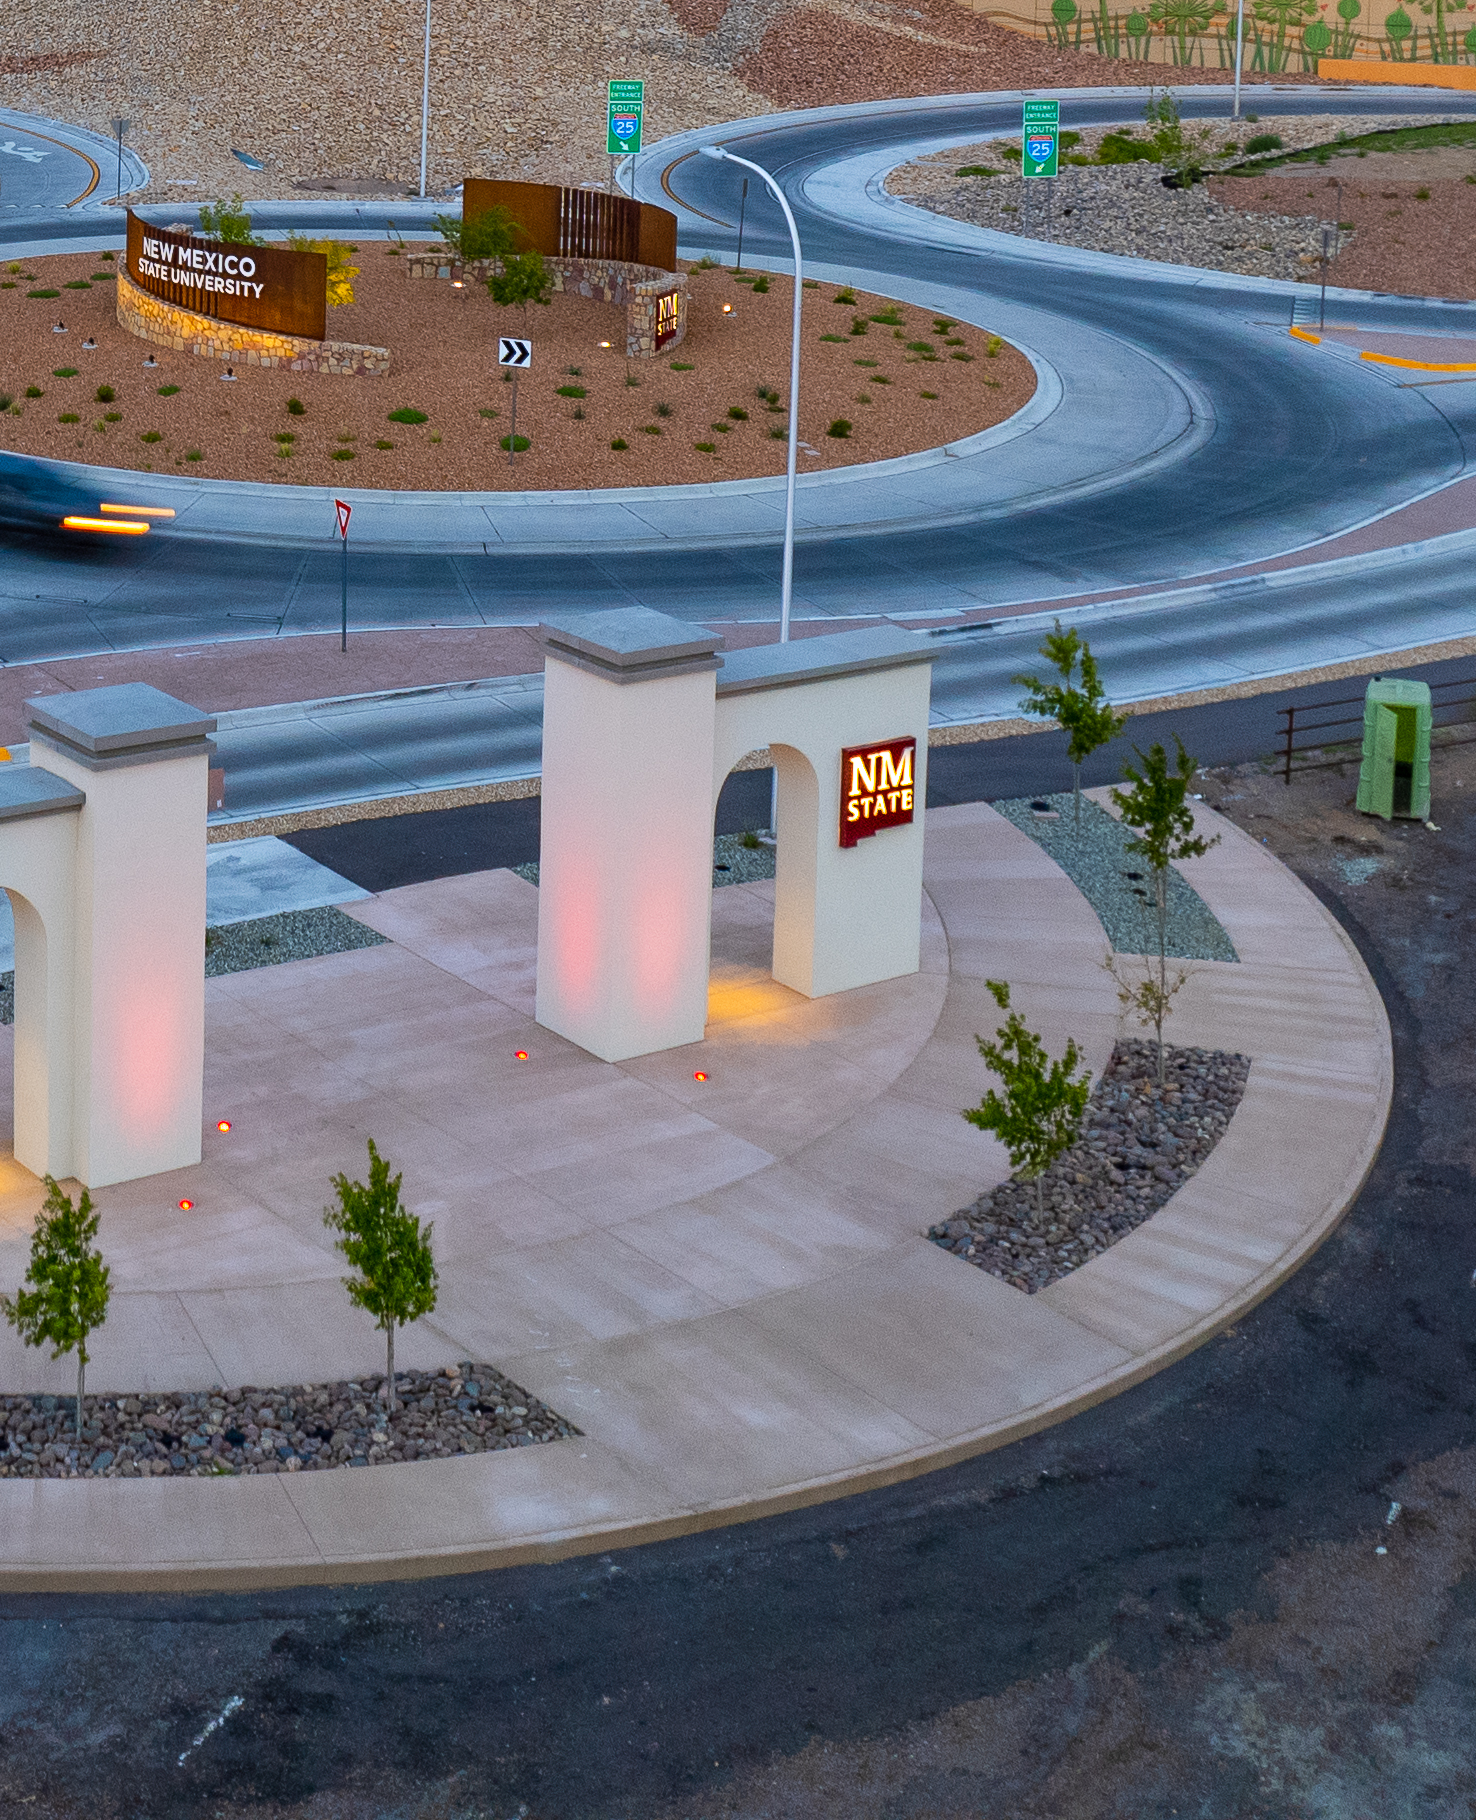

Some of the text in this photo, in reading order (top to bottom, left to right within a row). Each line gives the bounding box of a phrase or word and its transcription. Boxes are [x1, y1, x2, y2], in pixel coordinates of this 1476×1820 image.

[611, 104, 641, 112] SOUTH
[616, 121, 634, 134] 25
[1026, 125, 1056, 134] SOUTH
[1031, 143, 1050, 156] 25
[143, 236, 256, 278] NEW MEXICO
[138, 257, 264, 299] STATE UNIVERSITY
[658, 292, 678, 322] NM
[657, 316, 678, 336] STATE
[848, 746, 915, 797] NM
[847, 788, 914, 823] STATE
